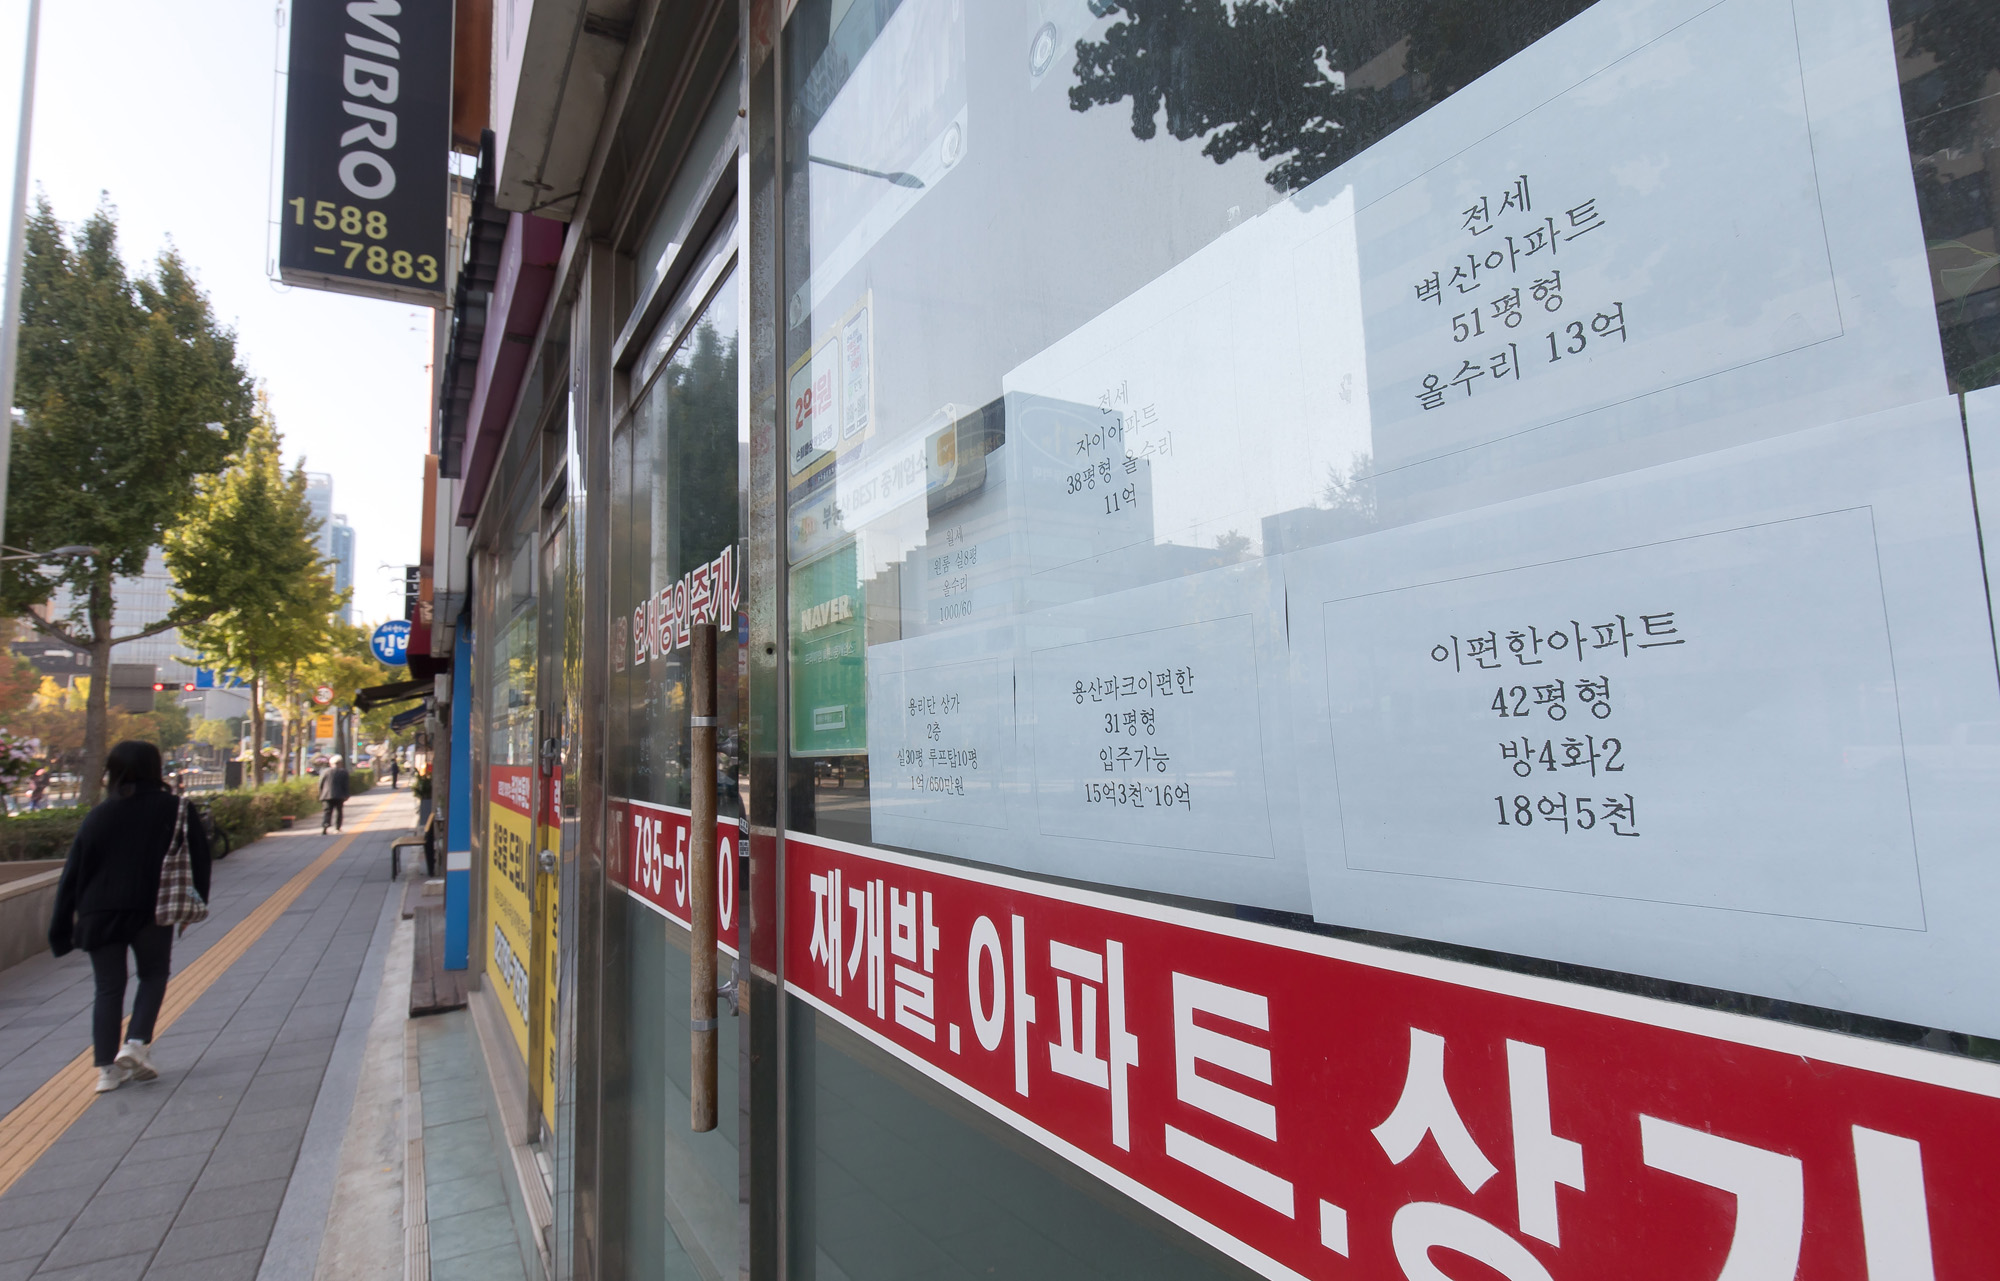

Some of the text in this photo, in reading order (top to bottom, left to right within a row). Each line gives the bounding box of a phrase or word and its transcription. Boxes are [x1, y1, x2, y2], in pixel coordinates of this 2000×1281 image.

[289, 197, 388, 240] 1588
[1461, 175, 1531, 236] 전세
[314, 240, 438, 283] -7883
[1414, 198, 1606, 306] 벽산아파트
[1452, 270, 1563, 343] 51평형
[1415, 302, 1627, 411] 올수리 13억
[1098, 380, 1129, 415] 전세
[1076, 403, 1159, 457] 자이아파트
[852, 478, 879, 511] BEST
[880, 449, 928, 498] 중개업소
[1066, 431, 1174, 495] 38평형 올수리
[1104, 482, 1137, 515] 11억
[934, 546, 978, 576] 원룸 실8평
[942, 574, 968, 598] 올수리
[801, 594, 853, 633] NAVER
[939, 600, 972, 623] 1000/60
[1431, 612, 1686, 674] 이편한아파트
[907, 693, 960, 717] 용리단 상가
[1072, 666, 1195, 705] 용산파크이편한
[1491, 675, 1612, 721] 42평형
[926, 722, 942, 742] 2층
[1104, 707, 1156, 736] 31평형
[928, 748, 979, 770] 루프탑10평
[1099, 745, 1170, 773] 입주가능
[1499, 734, 1625, 778] 방4화2
[1084, 782, 1192, 812] 15억3천~16억
[1494, 792, 1641, 837] 18억5천
[634, 814, 733, 931] 795-50
